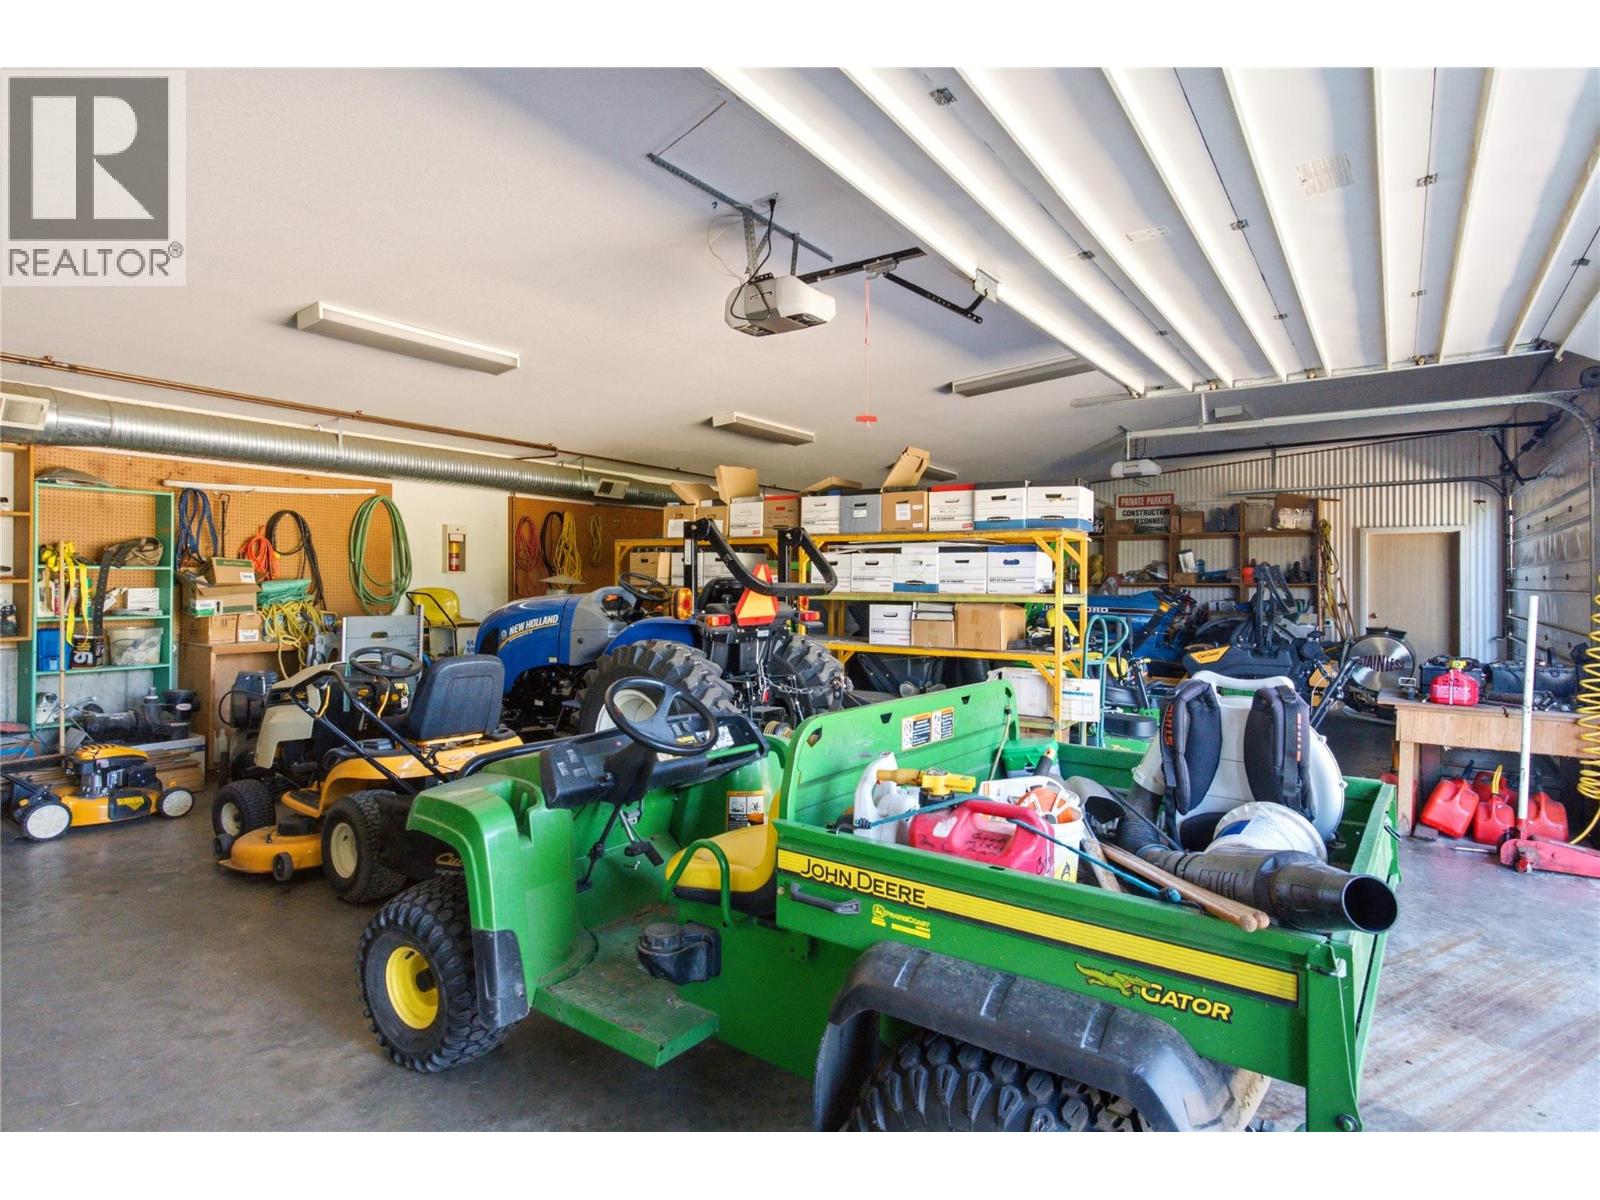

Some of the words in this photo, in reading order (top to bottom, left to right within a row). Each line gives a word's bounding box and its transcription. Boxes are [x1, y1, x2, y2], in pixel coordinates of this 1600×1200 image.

[1121, 496, 1145, 506] PRIVATE
[1147, 495, 1172, 505] PARKING
[509, 621, 525, 636] NEW
[525, 615, 559, 629] HOLLAND
[1357, 654, 1405, 673] STAINLESS
[800, 859, 852, 886] JOHN
[857, 871, 926, 906] DEERE
[1140, 983, 1233, 1021] GATOR
